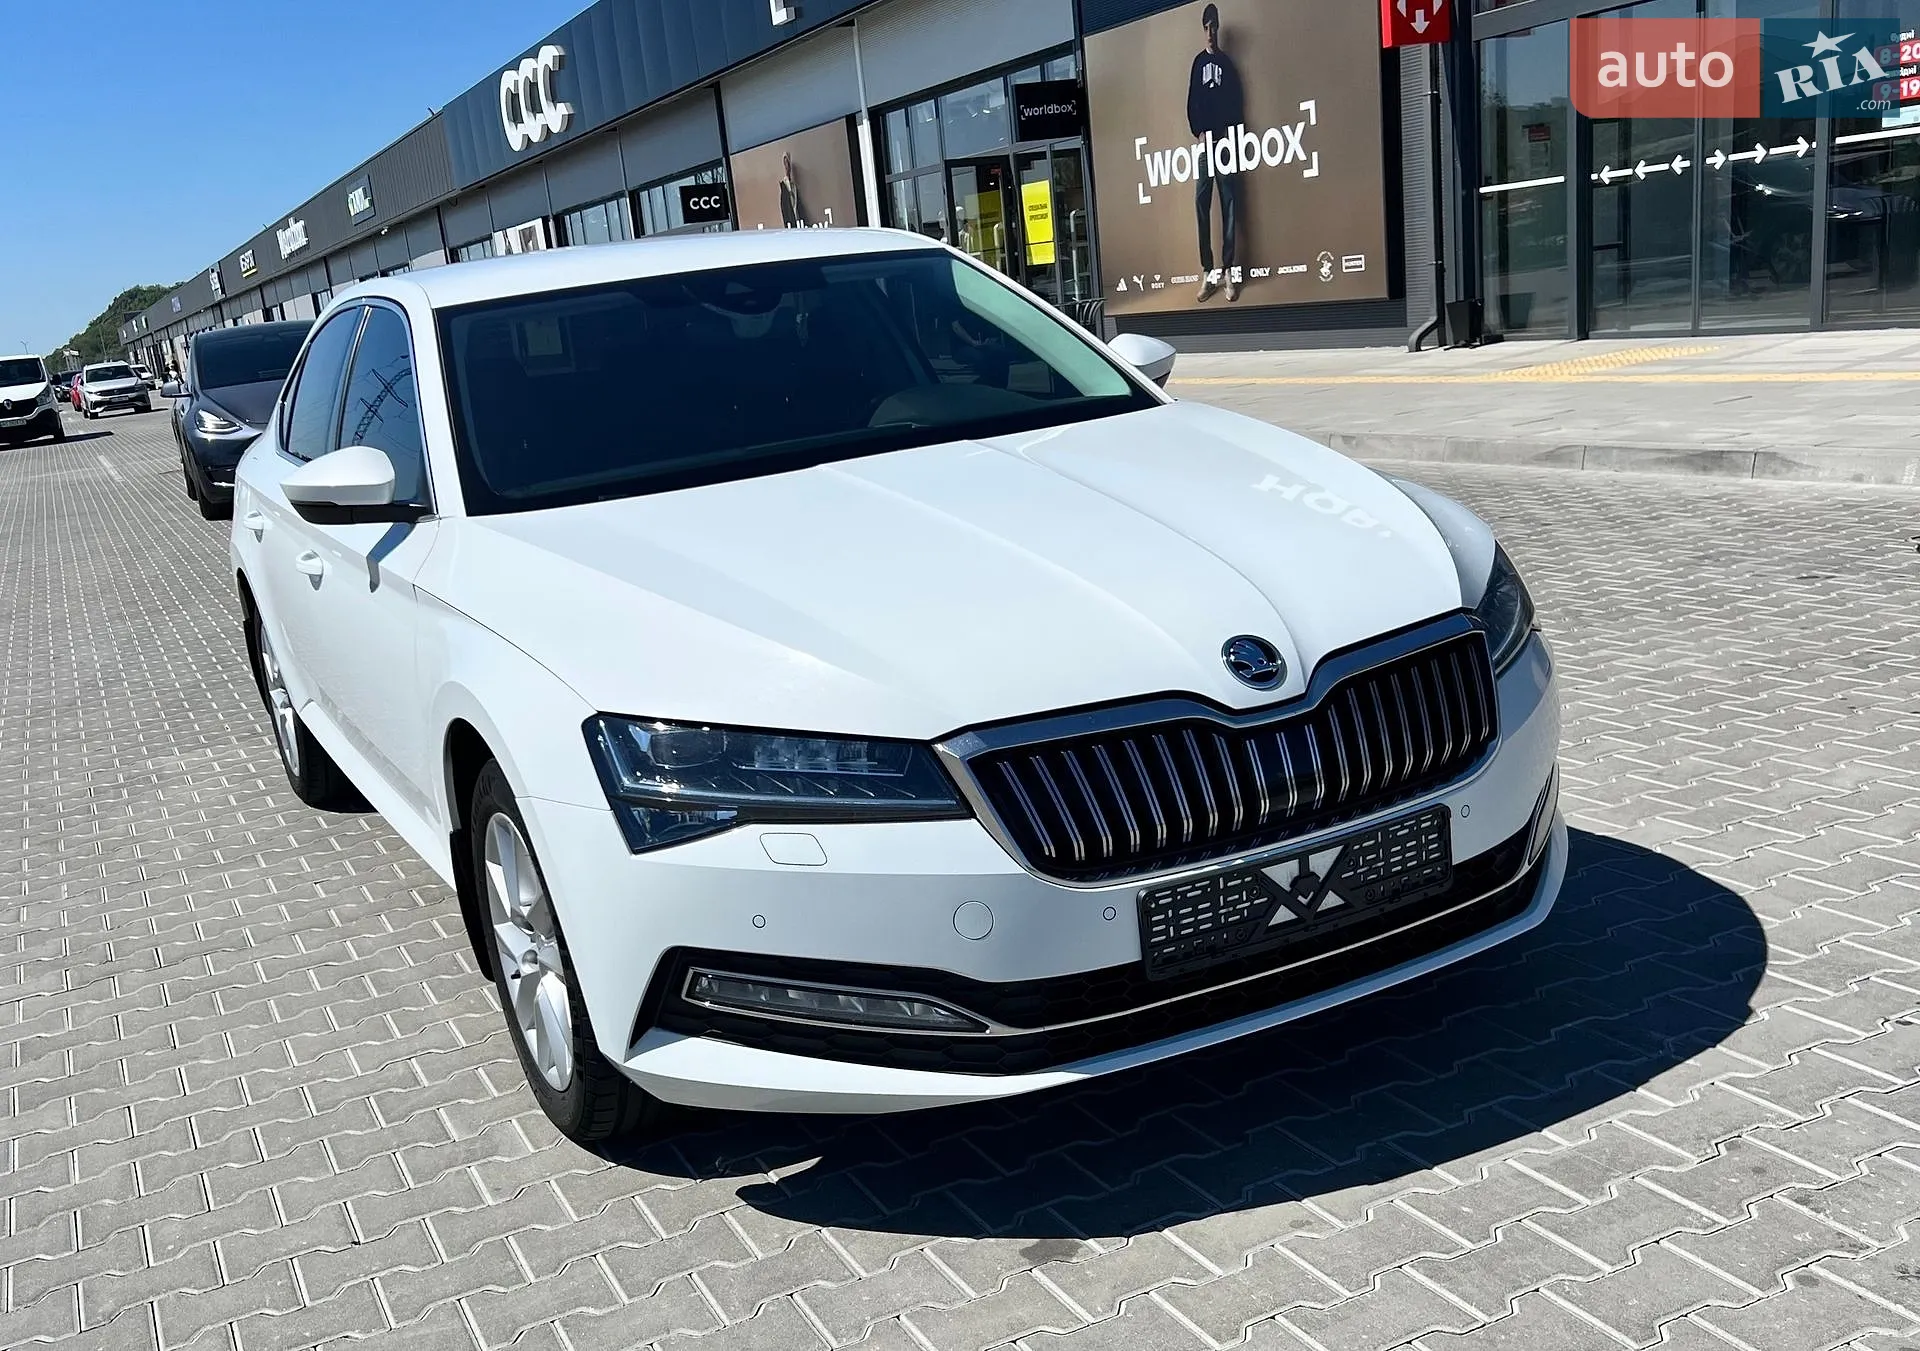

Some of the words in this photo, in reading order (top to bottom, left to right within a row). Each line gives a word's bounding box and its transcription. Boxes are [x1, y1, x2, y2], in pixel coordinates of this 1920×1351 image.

[500, 45, 571, 152] CCC
[1022, 103, 1074, 117] worldbox
[1142, 118, 1310, 189] worldbox
[689, 195, 721, 210] CCC
[1206, 268, 1223, 285] 4F
[1249, 267, 1271, 278] ONLY
